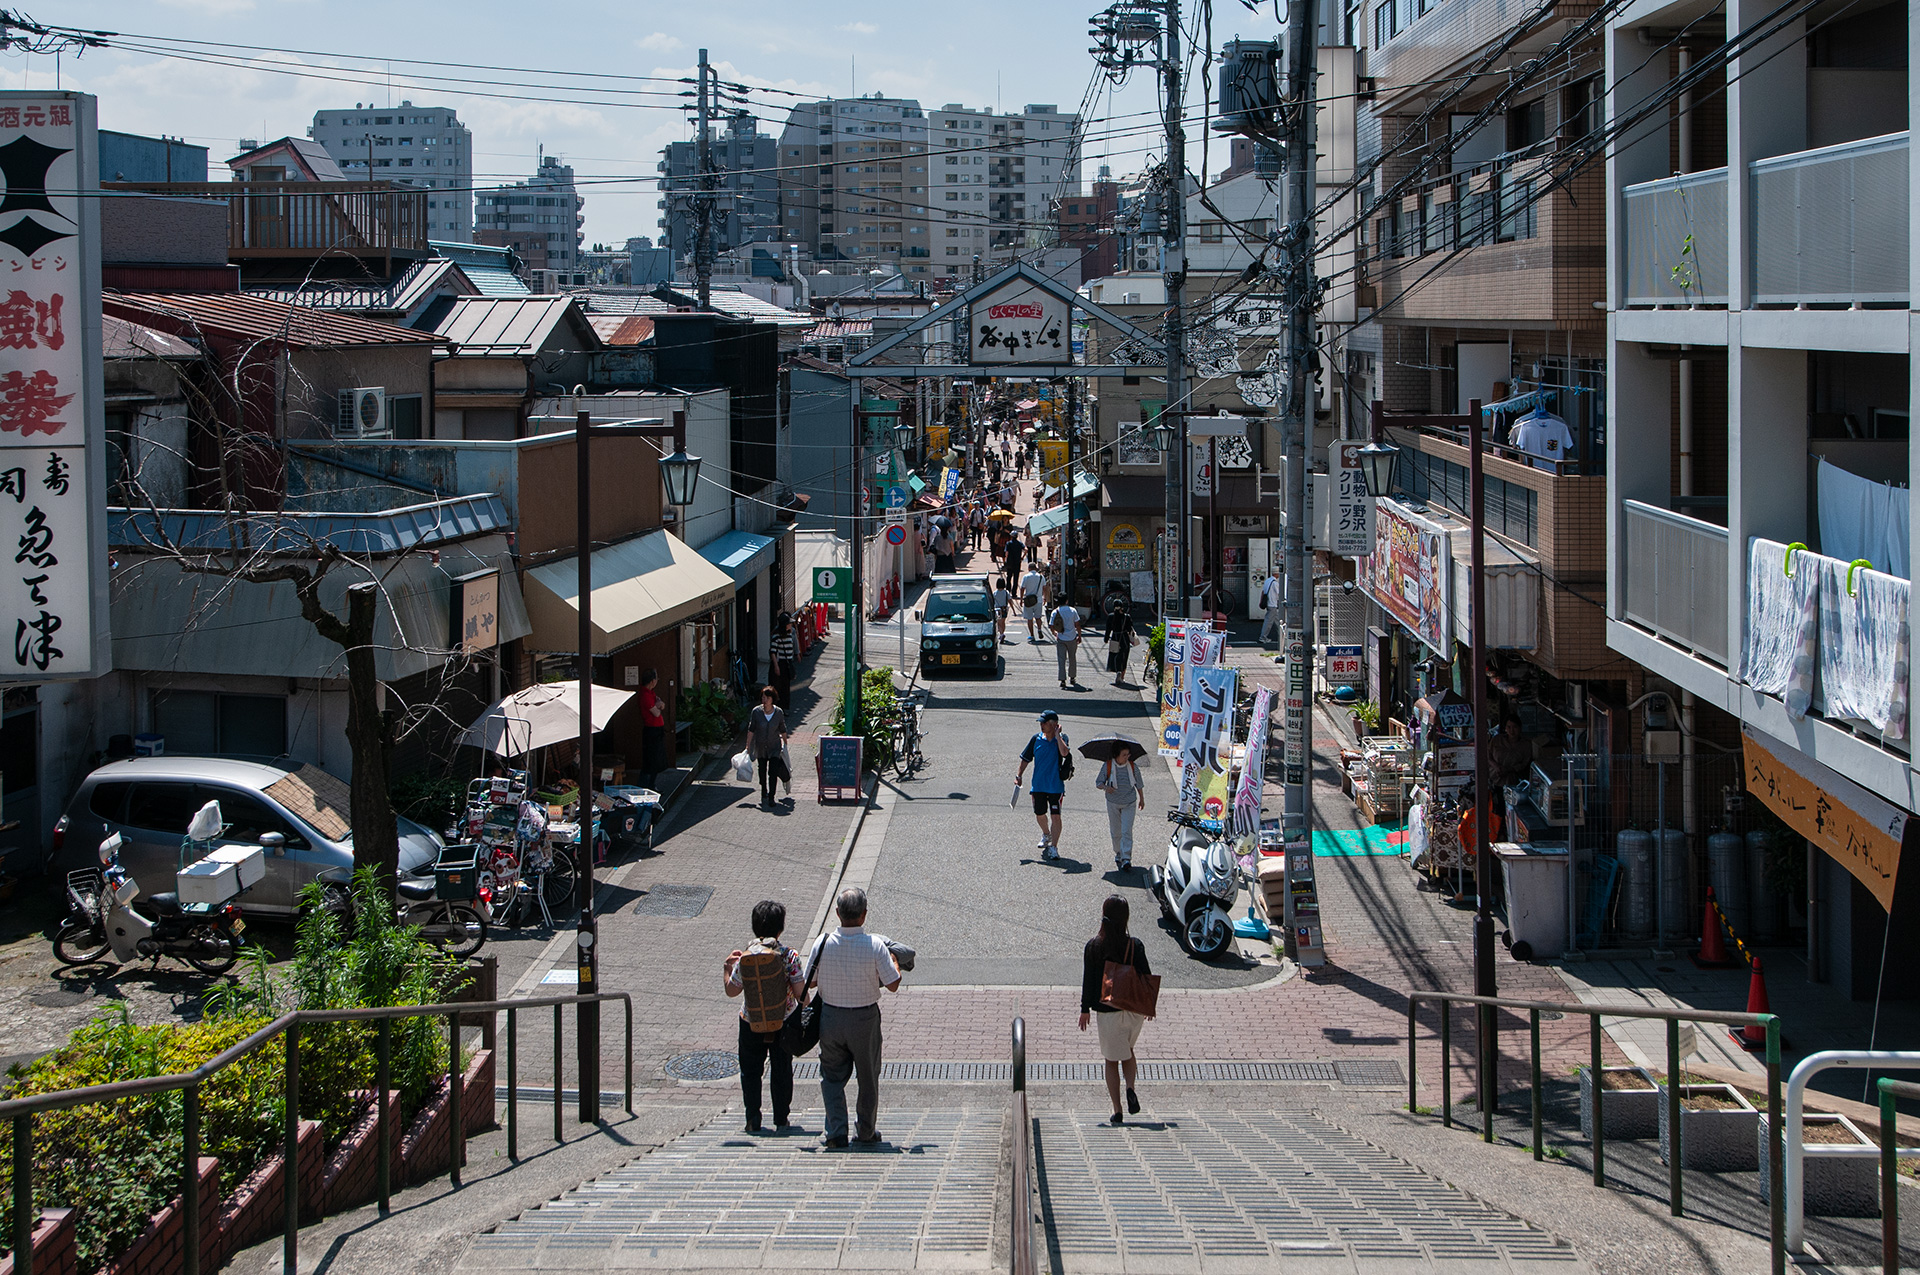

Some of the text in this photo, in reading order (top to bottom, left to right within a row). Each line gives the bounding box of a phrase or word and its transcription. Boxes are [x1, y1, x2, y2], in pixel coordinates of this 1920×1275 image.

[0, 255, 67, 272] ンビシ
[990, 302, 1043, 318] ひぐらしの里
[978, 315, 1062, 356] 谷中ぎんざ
[1339, 471, 1351, 530] クリニック
[1353, 471, 1366, 531] 動物・野沢
[1335, 648, 1353, 656] Asahi
[1333, 660, 1358, 672] 焼肉
[1441, 714, 1472, 727] レストラン
